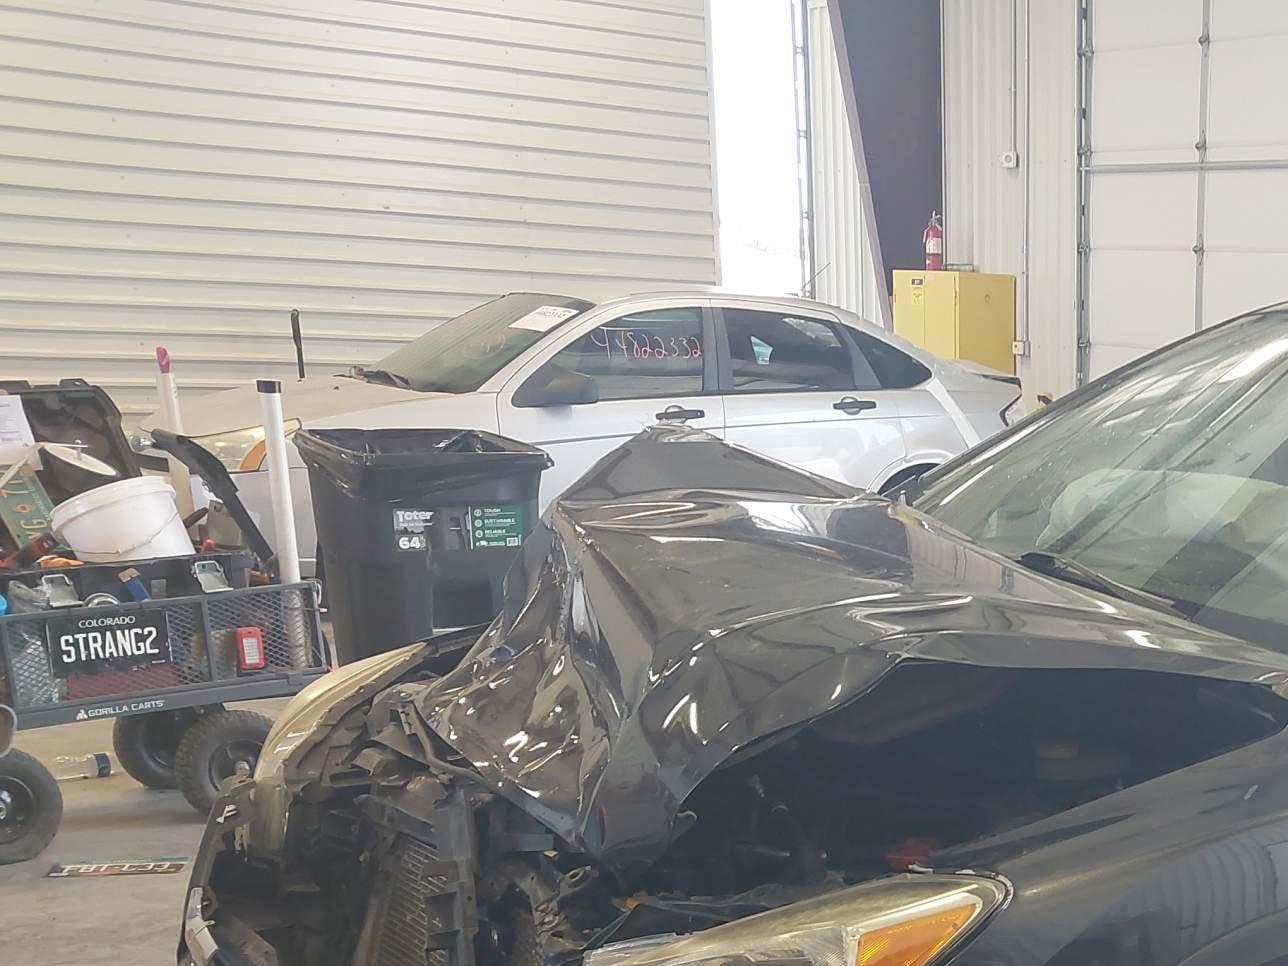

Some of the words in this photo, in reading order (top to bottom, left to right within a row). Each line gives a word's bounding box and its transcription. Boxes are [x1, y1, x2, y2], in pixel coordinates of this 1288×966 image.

[590, 331, 702, 360] 44822332
[396, 510, 434, 522] Toter
[399, 537, 421, 549] 64
[78, 616, 136, 628] COLORADO
[60, 627, 159, 662] STRANG2
[88, 705, 129, 717] GORILLA
[131, 700, 164, 711] CARTS
